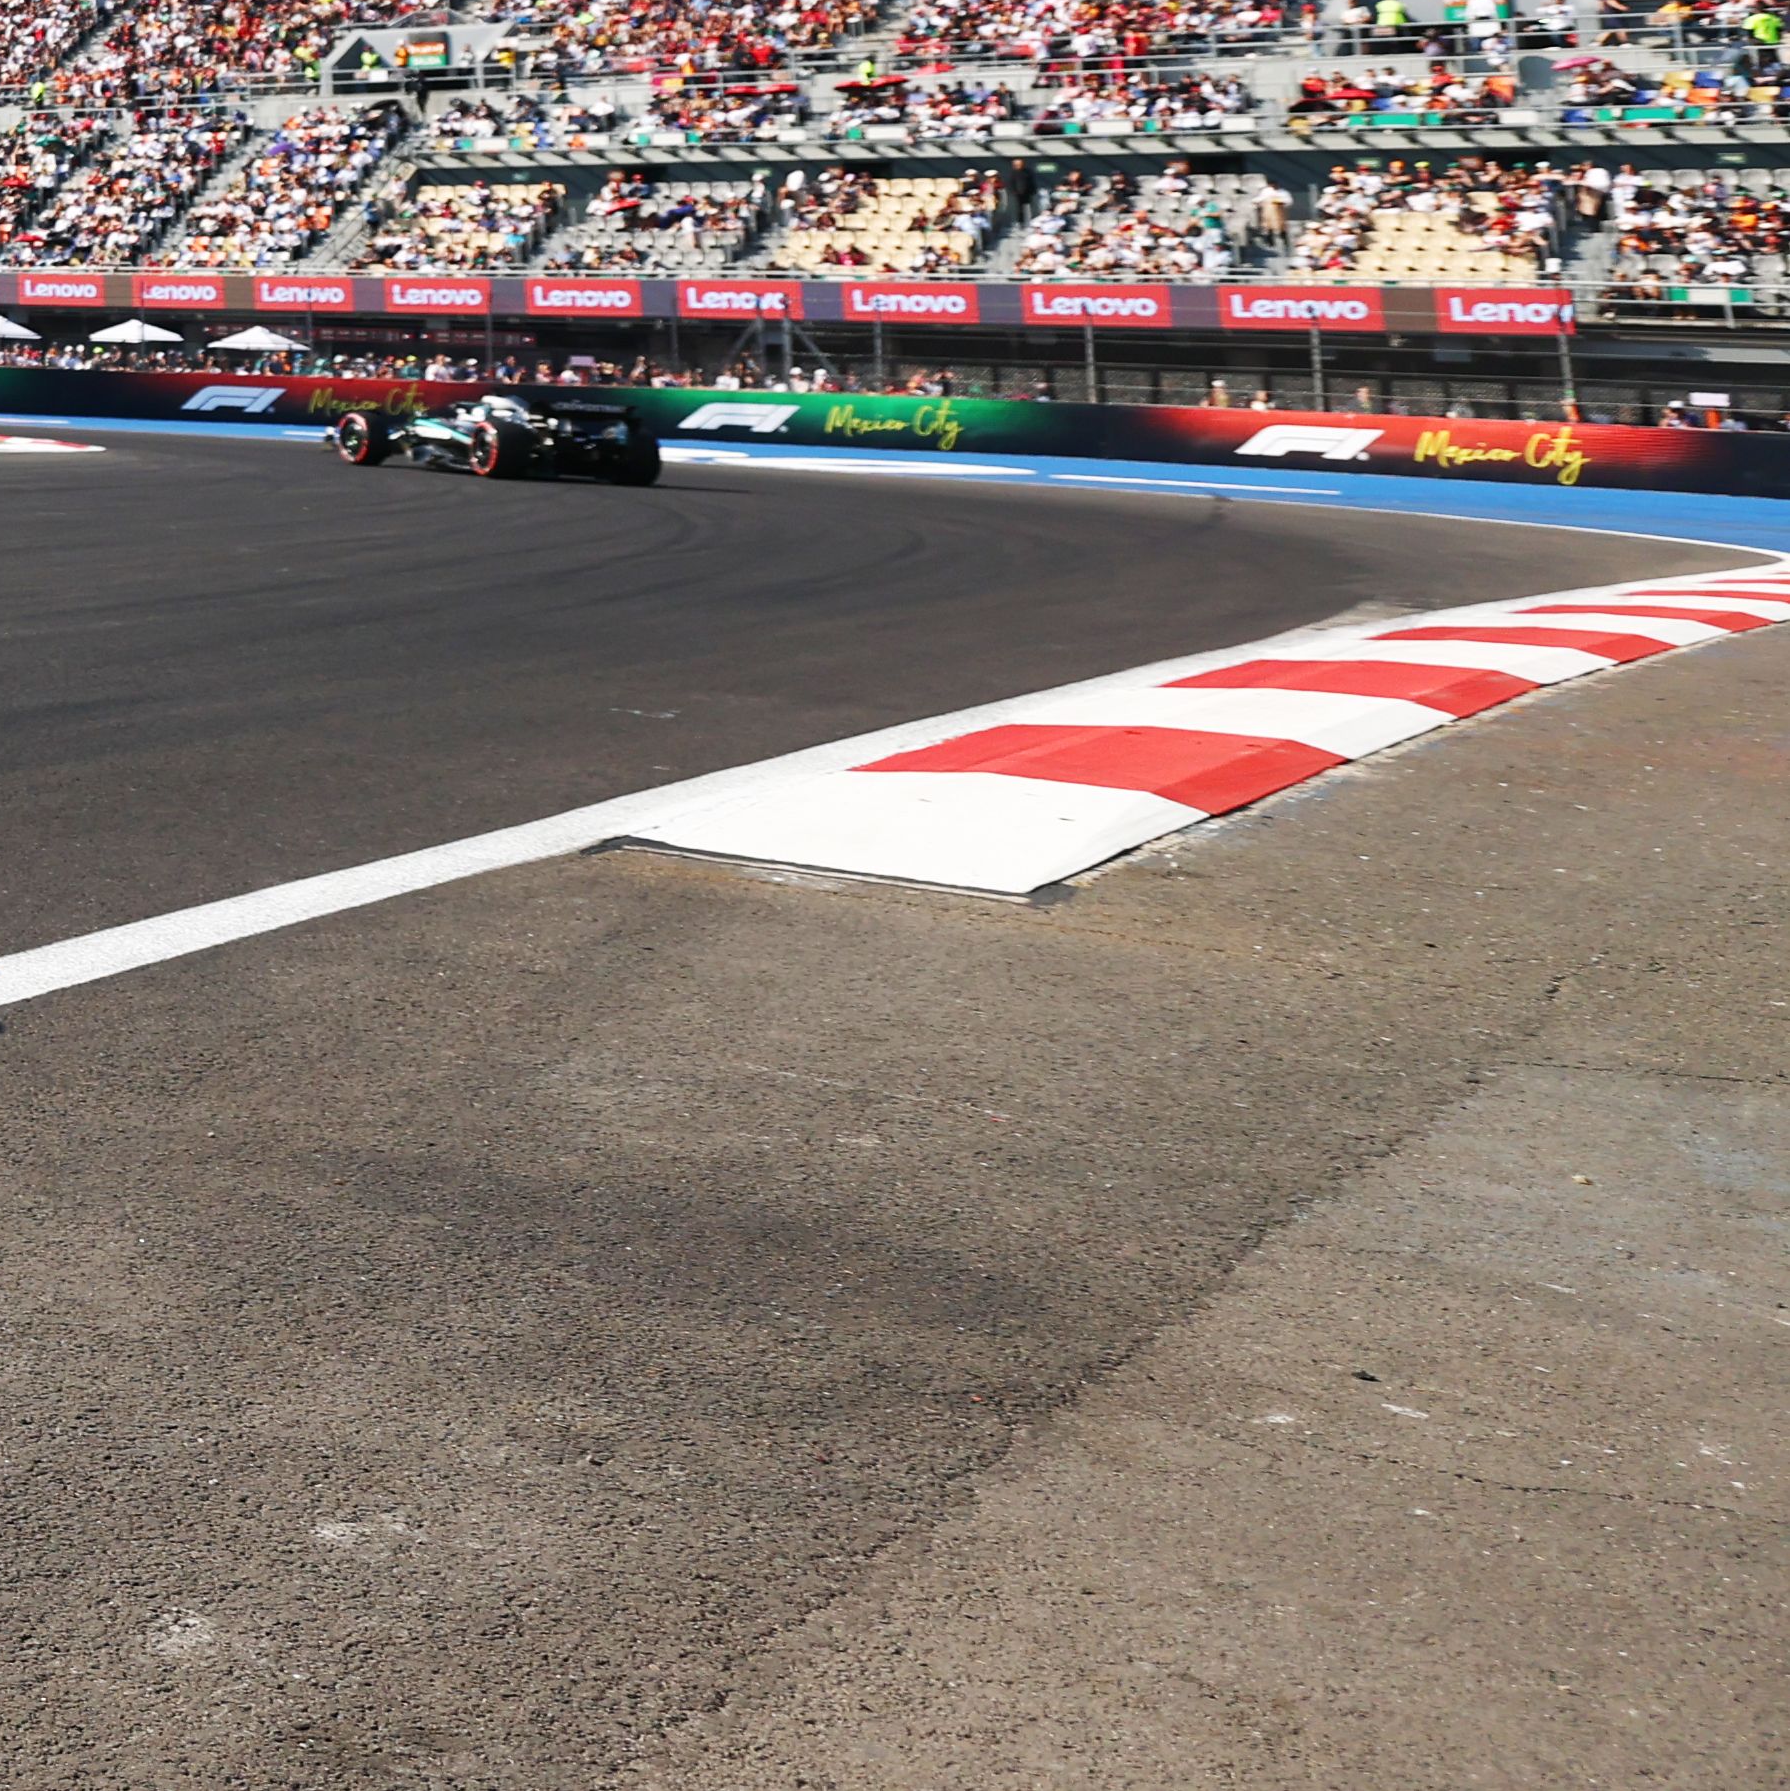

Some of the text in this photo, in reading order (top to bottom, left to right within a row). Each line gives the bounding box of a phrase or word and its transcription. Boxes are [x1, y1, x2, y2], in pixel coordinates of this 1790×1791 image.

[24, 279, 98, 298] Lenovo
[260, 282, 345, 304] Lenovo
[392, 284, 483, 306] Lenovo
[533, 285, 632, 308] Lenovo
[852, 289, 967, 314] Lenovo
[1032, 292, 1158, 317] Lenovo
[1230, 294, 1369, 320] Lenovo
[181, 385, 286, 413] F1
[307, 386, 381, 416] Mexico
[678, 401, 802, 433] F1
[824, 398, 965, 451] Mexico City
[1234, 424, 1385, 461] F1
[1414, 425, 1592, 486] Mexico City
